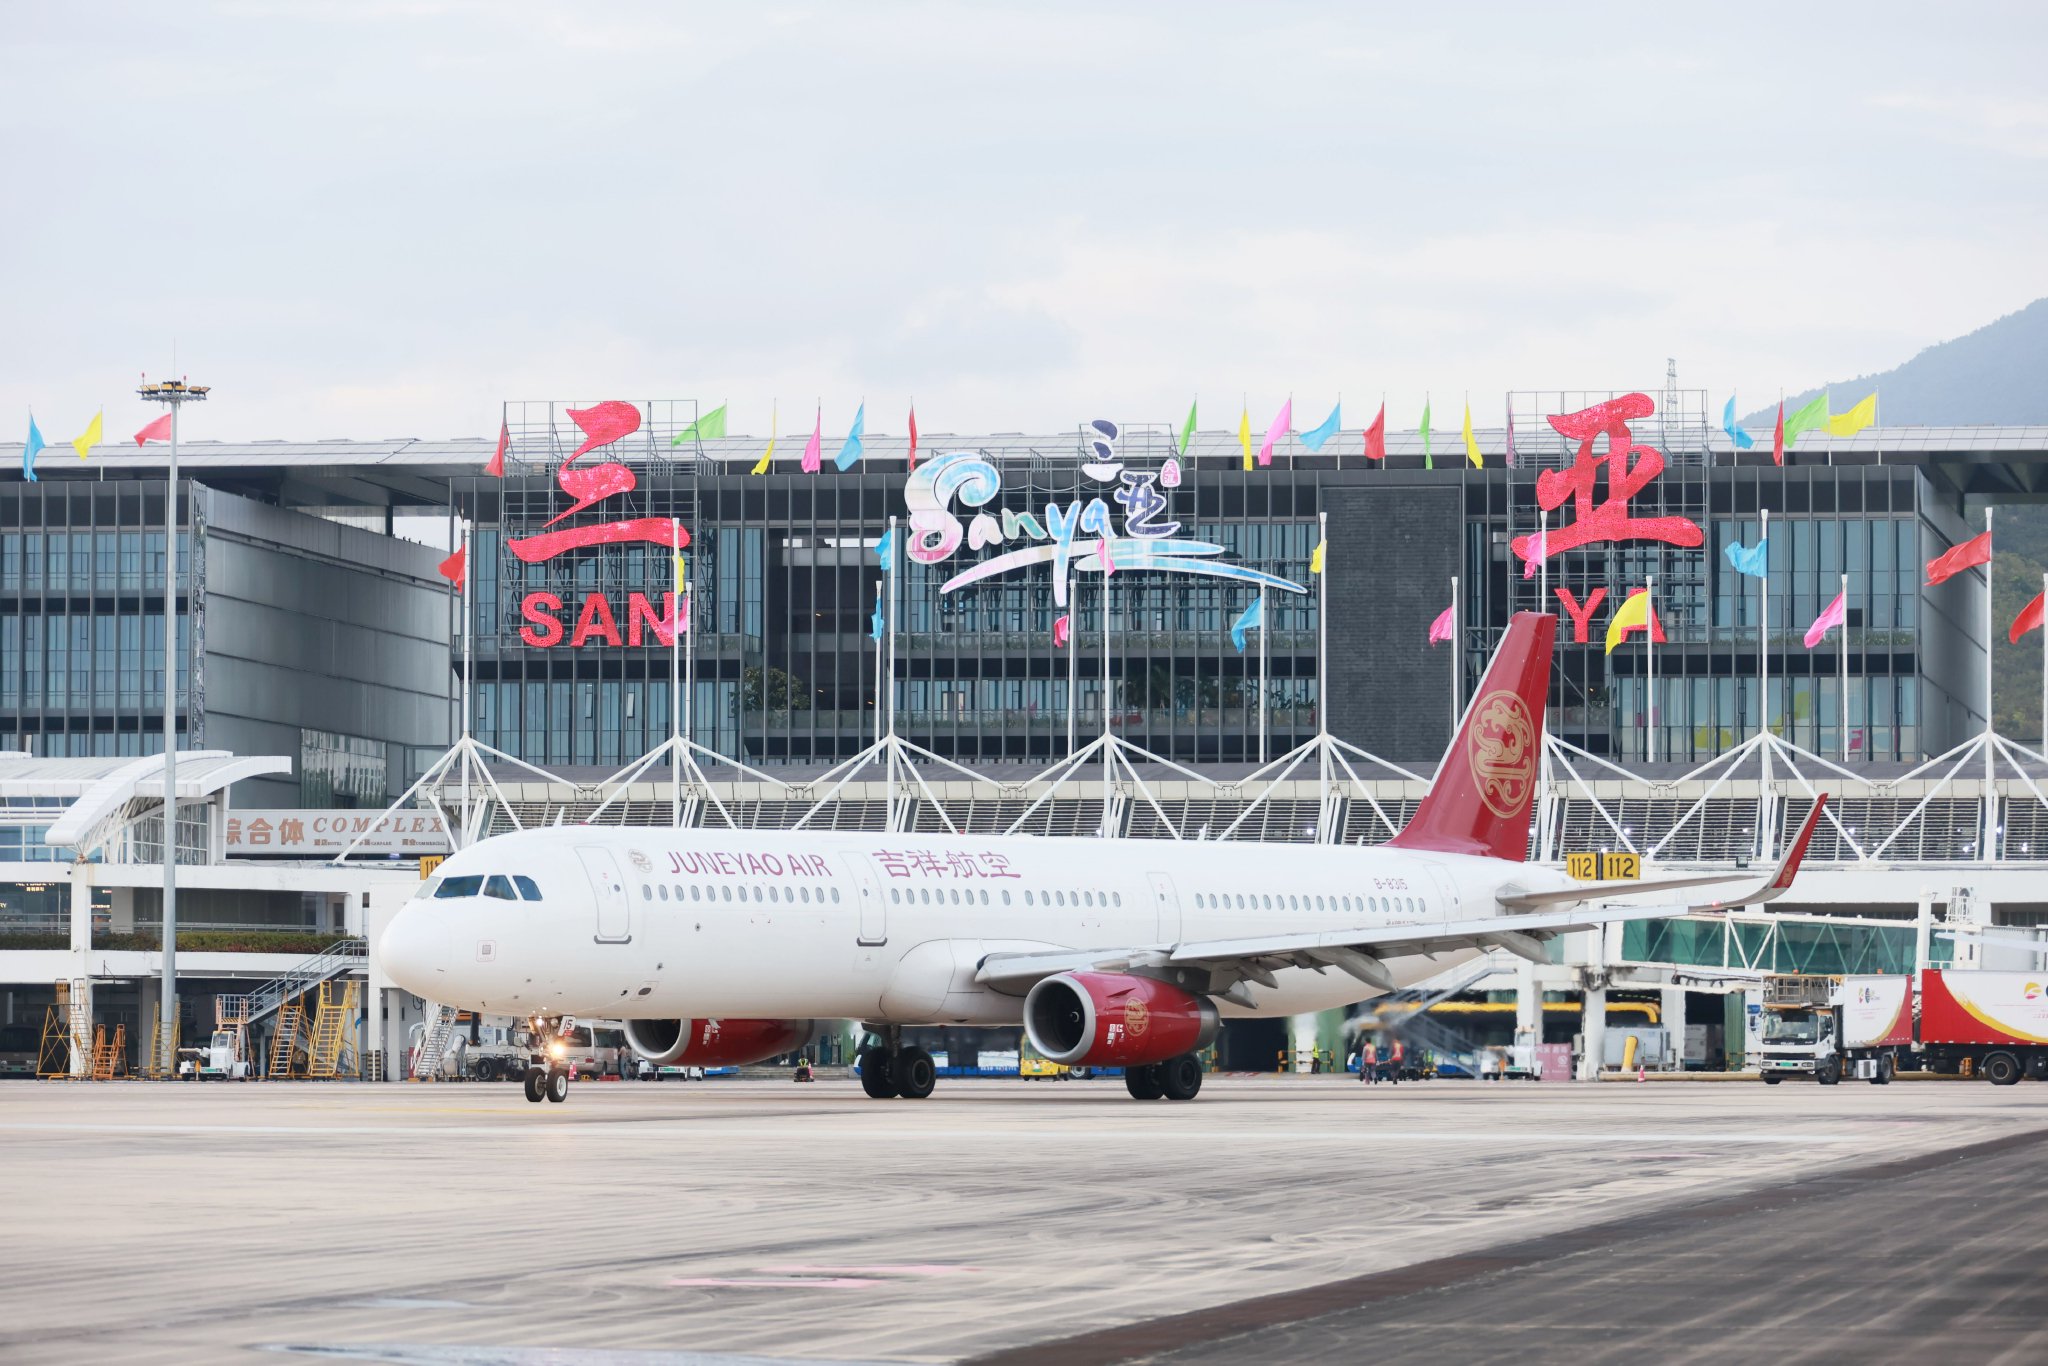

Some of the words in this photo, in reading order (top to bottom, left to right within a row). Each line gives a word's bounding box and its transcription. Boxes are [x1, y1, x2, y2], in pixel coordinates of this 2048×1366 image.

[507, 401, 691, 563] 三
[1511, 393, 1704, 561] 亚
[519, 592, 677, 647] SAN
[313, 817, 445, 833] COMPLEX
[668, 852, 783, 876] JUNEYAO
[787, 854, 832, 877] AIR
[872, 849, 1021, 878] 吉祥航空
[1571, 857, 1592, 877] 112
[1608, 857, 1634, 877] 112
[1374, 878, 1408, 890] B-8315
[563, 1019, 573, 1029] 15
